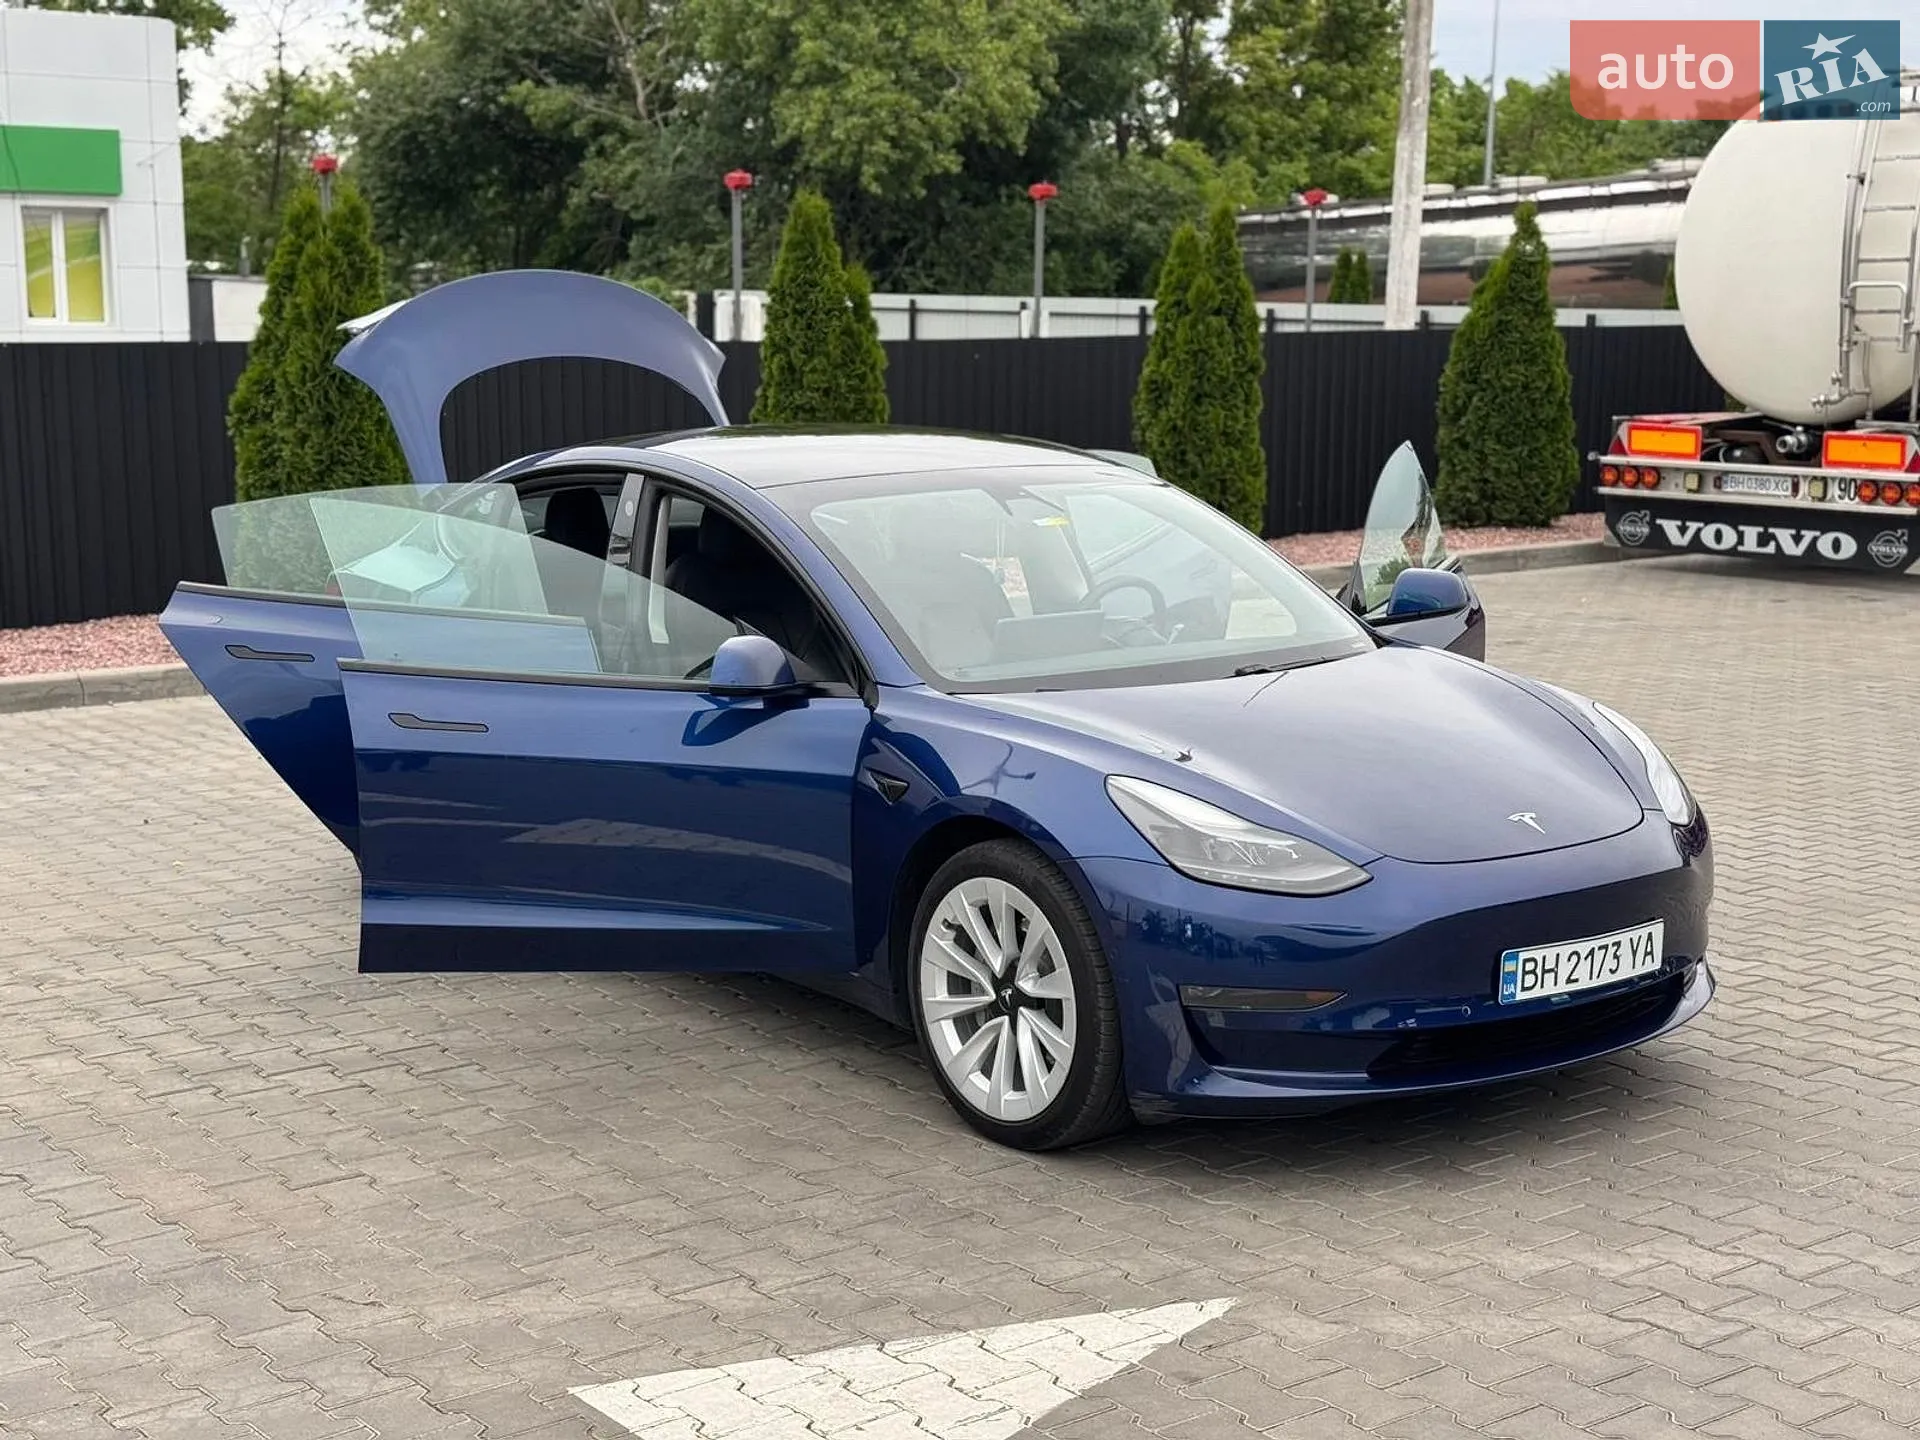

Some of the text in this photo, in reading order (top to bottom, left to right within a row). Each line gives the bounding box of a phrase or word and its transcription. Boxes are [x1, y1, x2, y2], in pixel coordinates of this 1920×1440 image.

[1838, 478, 1857, 501] 90
[1656, 519, 1857, 560] VOLVO
[1520, 931, 1655, 992] BH 2173 YA
